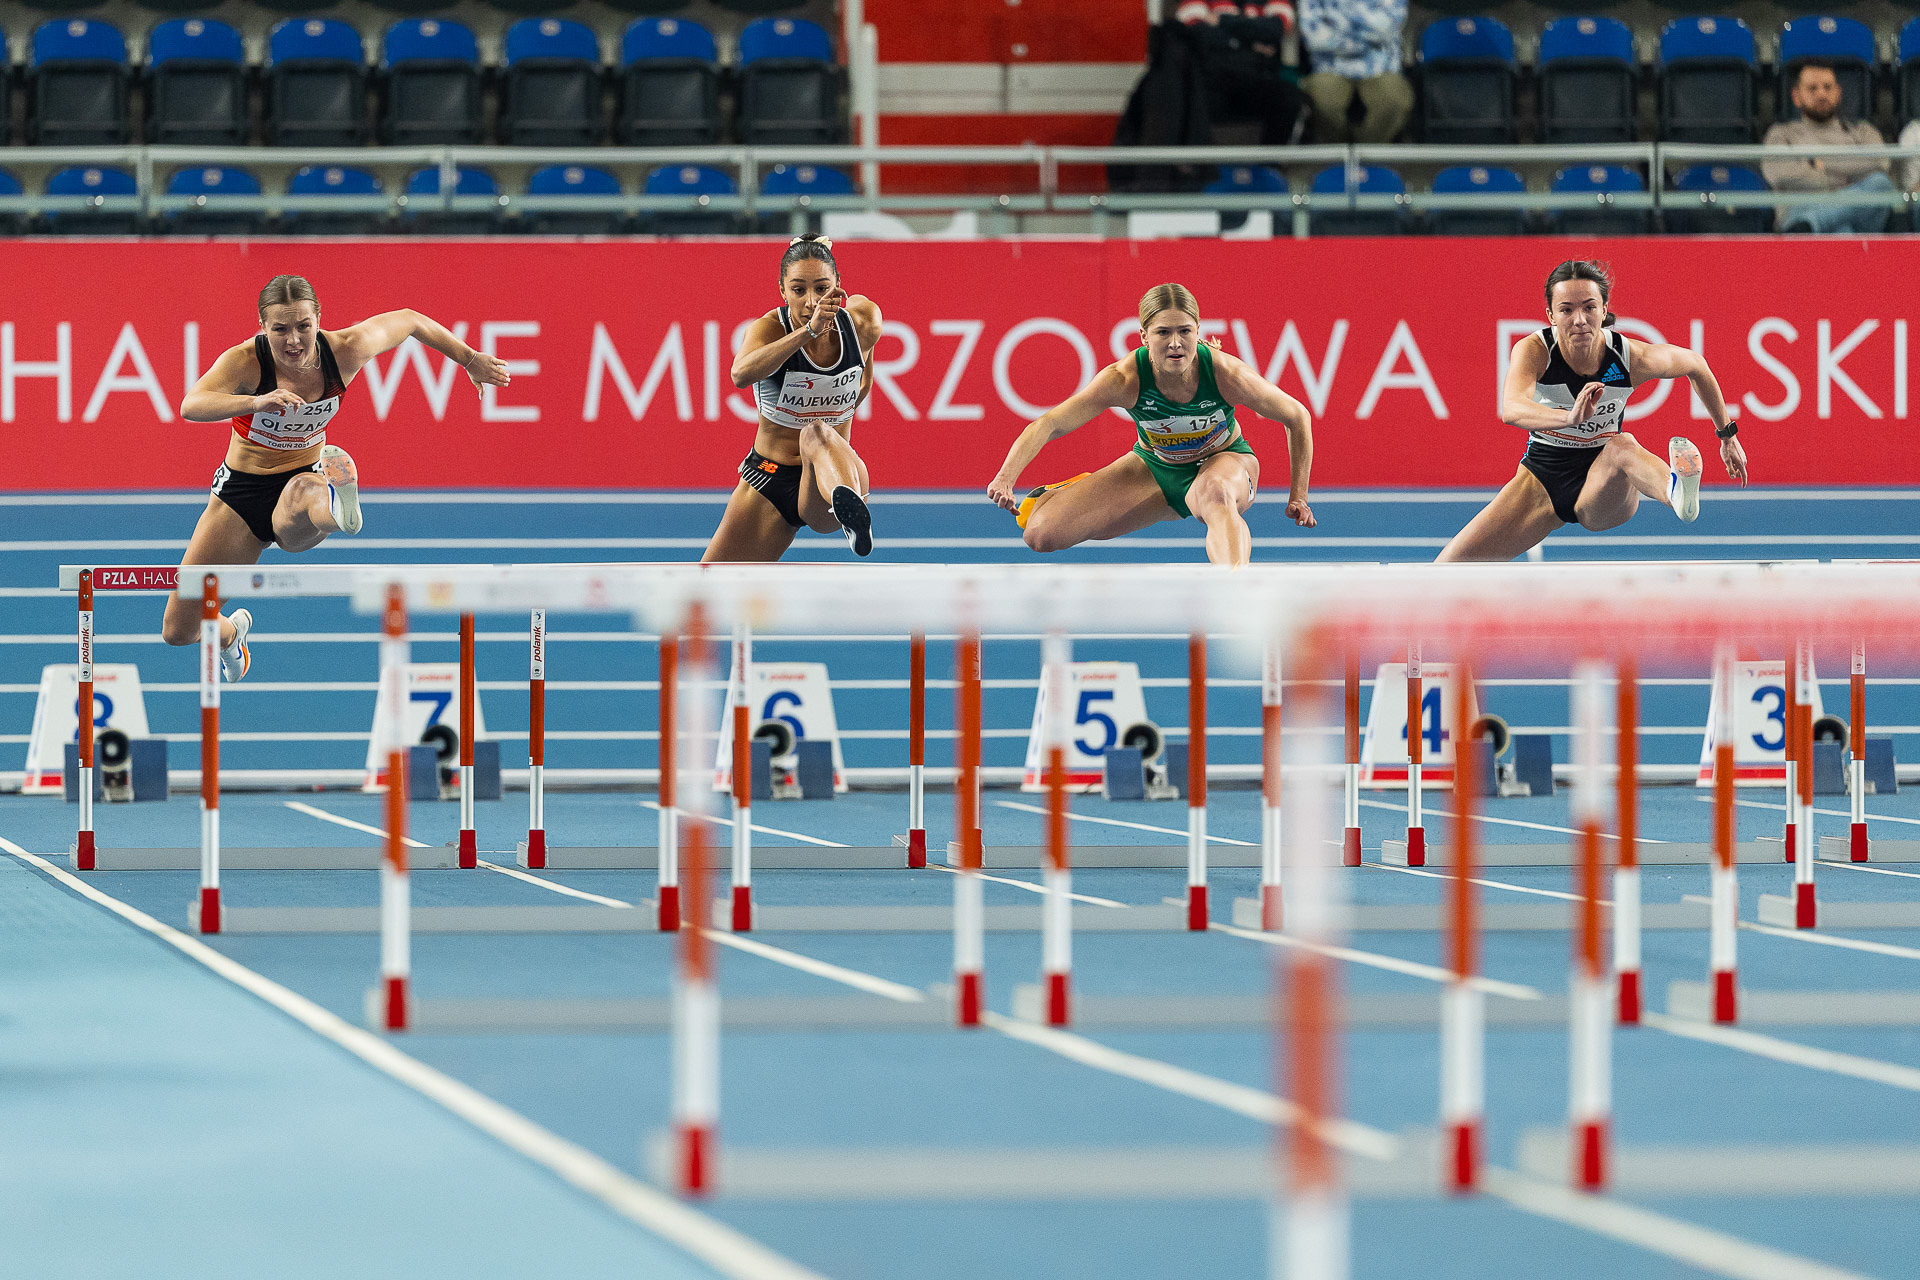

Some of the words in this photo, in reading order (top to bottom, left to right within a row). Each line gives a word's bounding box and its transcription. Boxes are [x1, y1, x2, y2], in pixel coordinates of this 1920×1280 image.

[1, 321, 540, 422] HALWE
[582, 317, 1450, 422] MIRZOWA
[1601, 374, 1624, 383] adidas
[832, 370, 857, 388] 105
[781, 390, 857, 407] MAJEWSKA
[303, 402, 333, 415] 254
[1593, 402, 1616, 416] 28
[1189, 415, 1219, 431] 175
[1568, 418, 1615, 433] ĘSNA
[267, 440, 292, 449] TORUŃ
[102, 571, 139, 585] PZLA
[81, 627, 91, 665] polanik
[533, 626, 543, 662] polanik
[409, 692, 452, 729] 7
[763, 690, 804, 738] 6
[1402, 686, 1449, 753] 4
[1751, 686, 1786, 751] 3
[1074, 690, 1117, 756] 5
